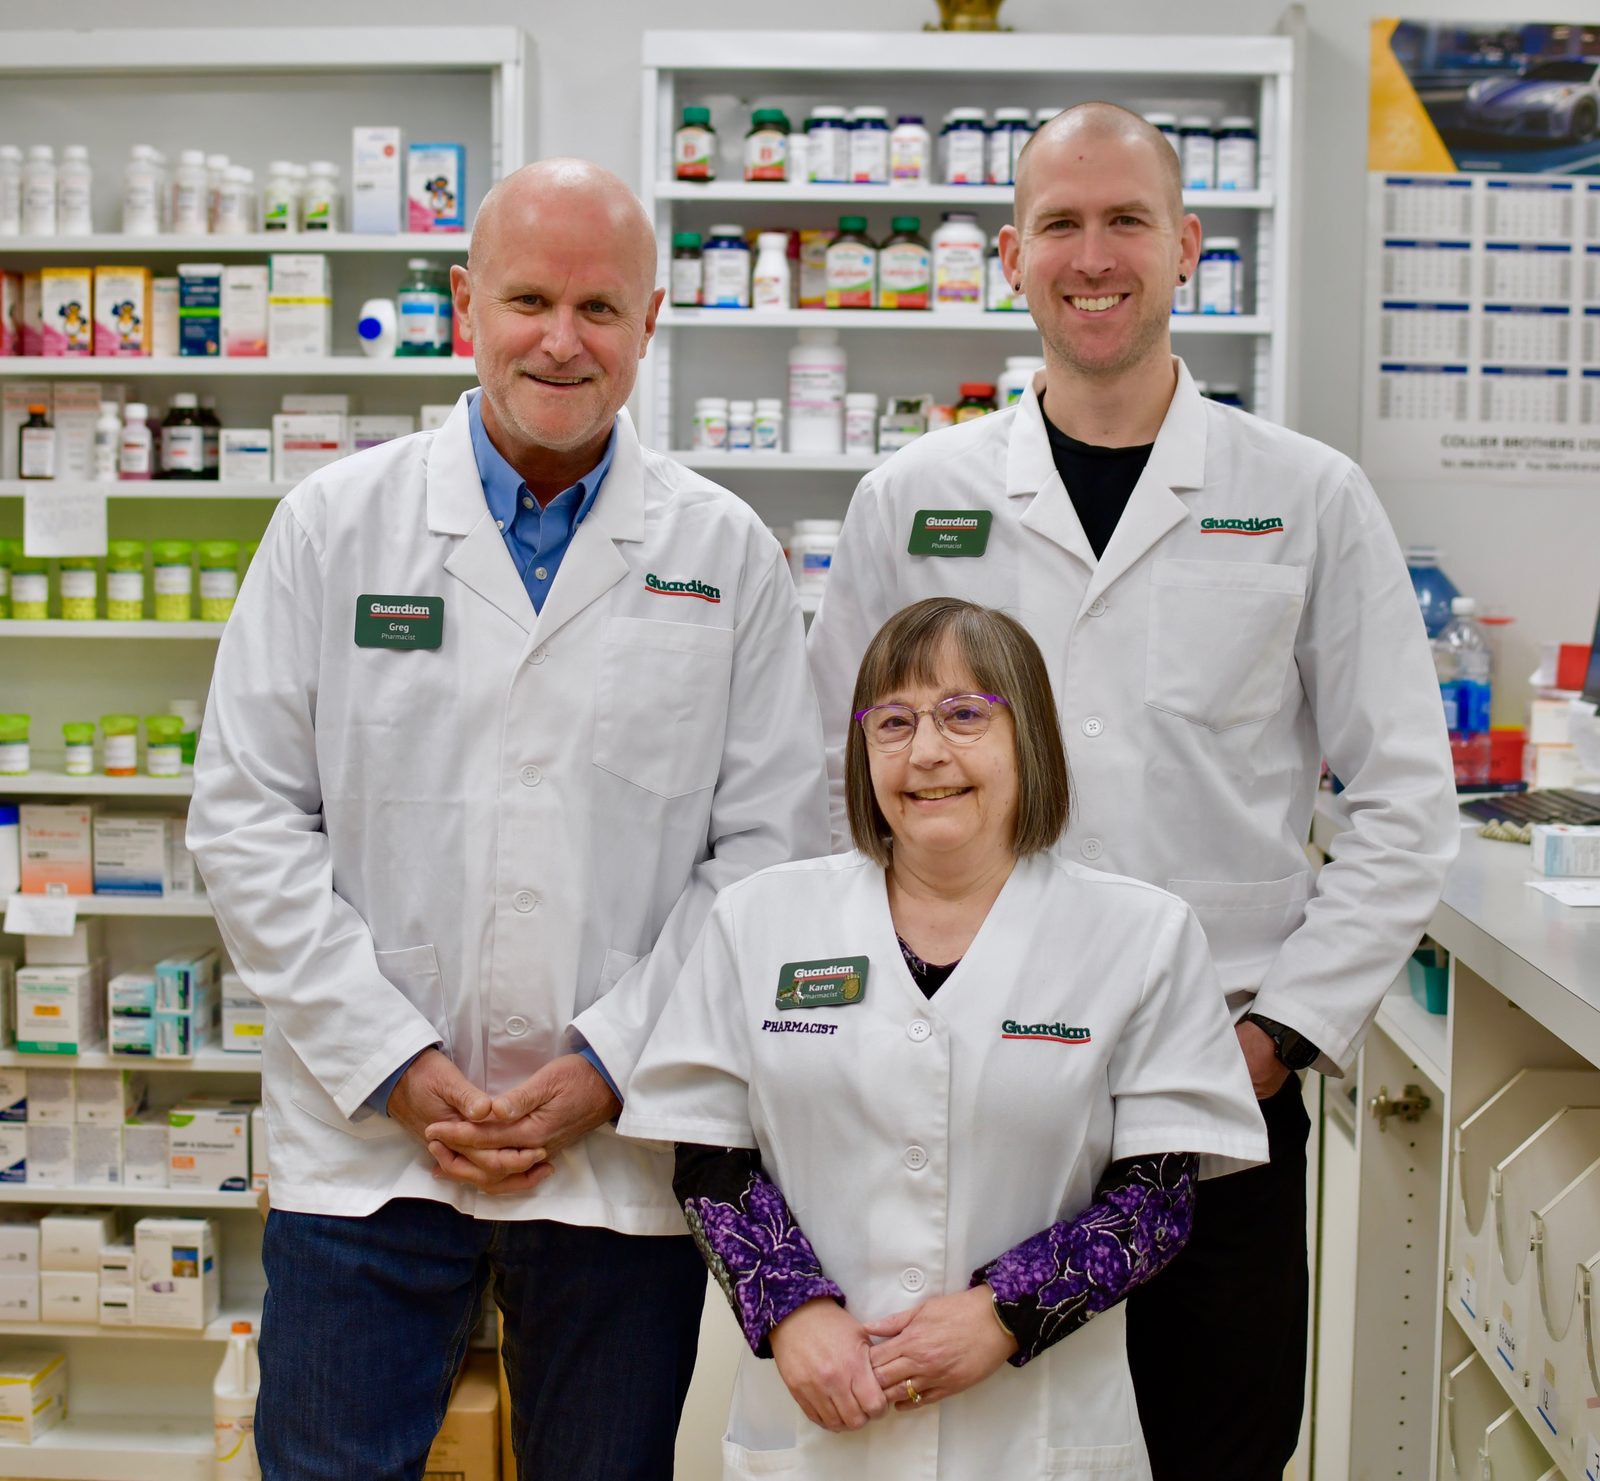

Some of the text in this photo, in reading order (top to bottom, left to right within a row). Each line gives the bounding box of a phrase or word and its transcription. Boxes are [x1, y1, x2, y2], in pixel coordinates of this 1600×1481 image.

[926, 516, 978, 527] Guardian
[1201, 517, 1283, 531] Guardian
[939, 533, 959, 542] Marc
[645, 573, 721, 599] Guardian
[370, 603, 430, 615] Guardian
[389, 622, 410, 634] Greg
[381, 632, 416, 641] Pharmacist
[794, 965, 854, 978] Guardian
[808, 983, 835, 993] Karen
[803, 991, 838, 1000] Pharmacist
[762, 1020, 838, 1035] PHARMACIST
[1002, 1019, 1091, 1039] Guardian
